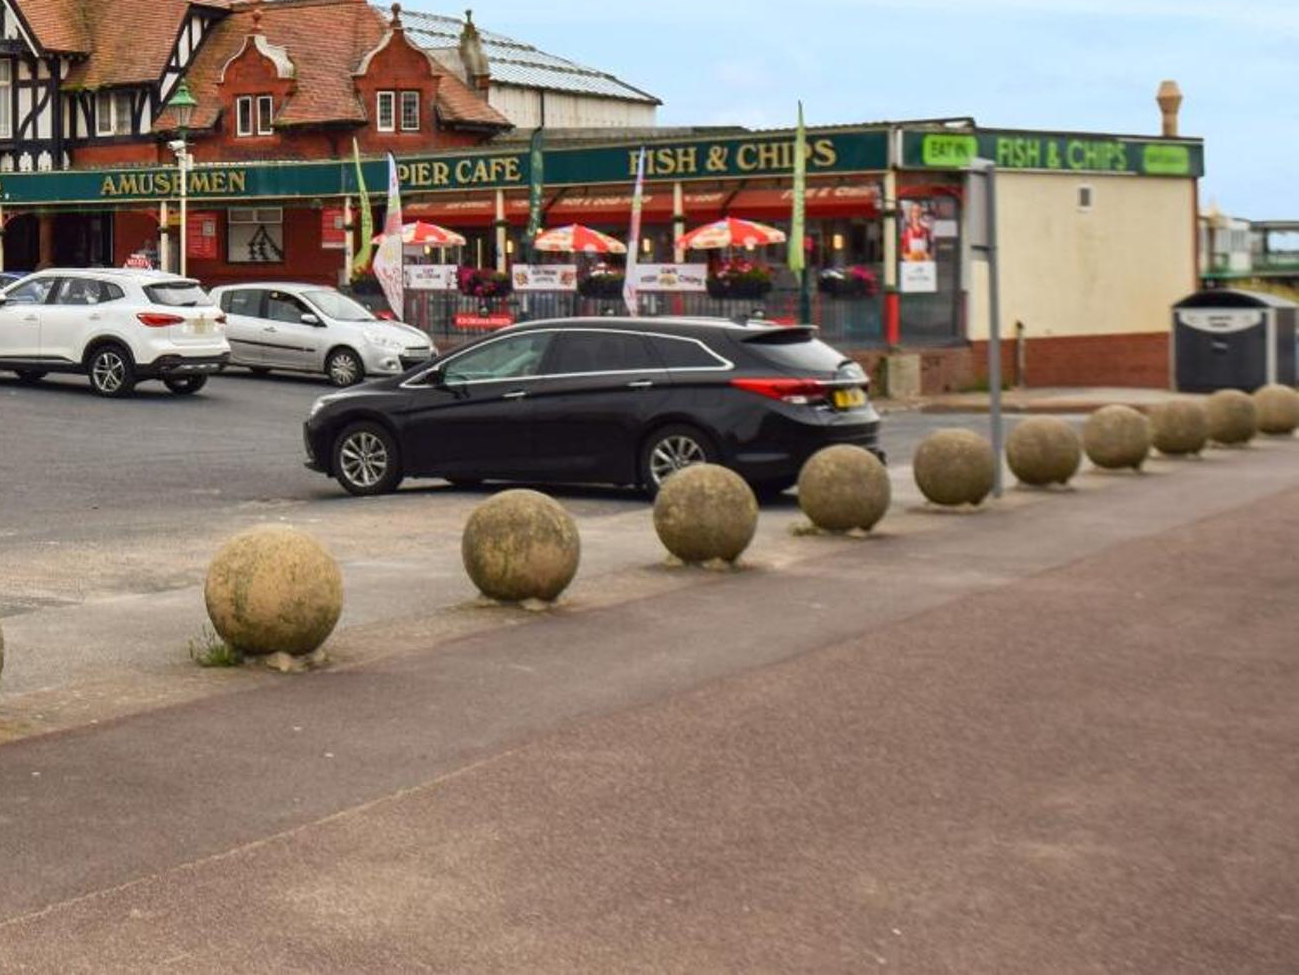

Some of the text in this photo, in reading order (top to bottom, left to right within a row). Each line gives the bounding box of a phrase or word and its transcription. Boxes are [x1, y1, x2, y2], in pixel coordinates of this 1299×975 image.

[629, 147, 697, 175] FISH
[706, 145, 729, 172] &
[930, 139, 953, 159] EAT
[996, 137, 1127, 171] FISH & CHIPS
[397, 157, 522, 186] PIER CAFE
